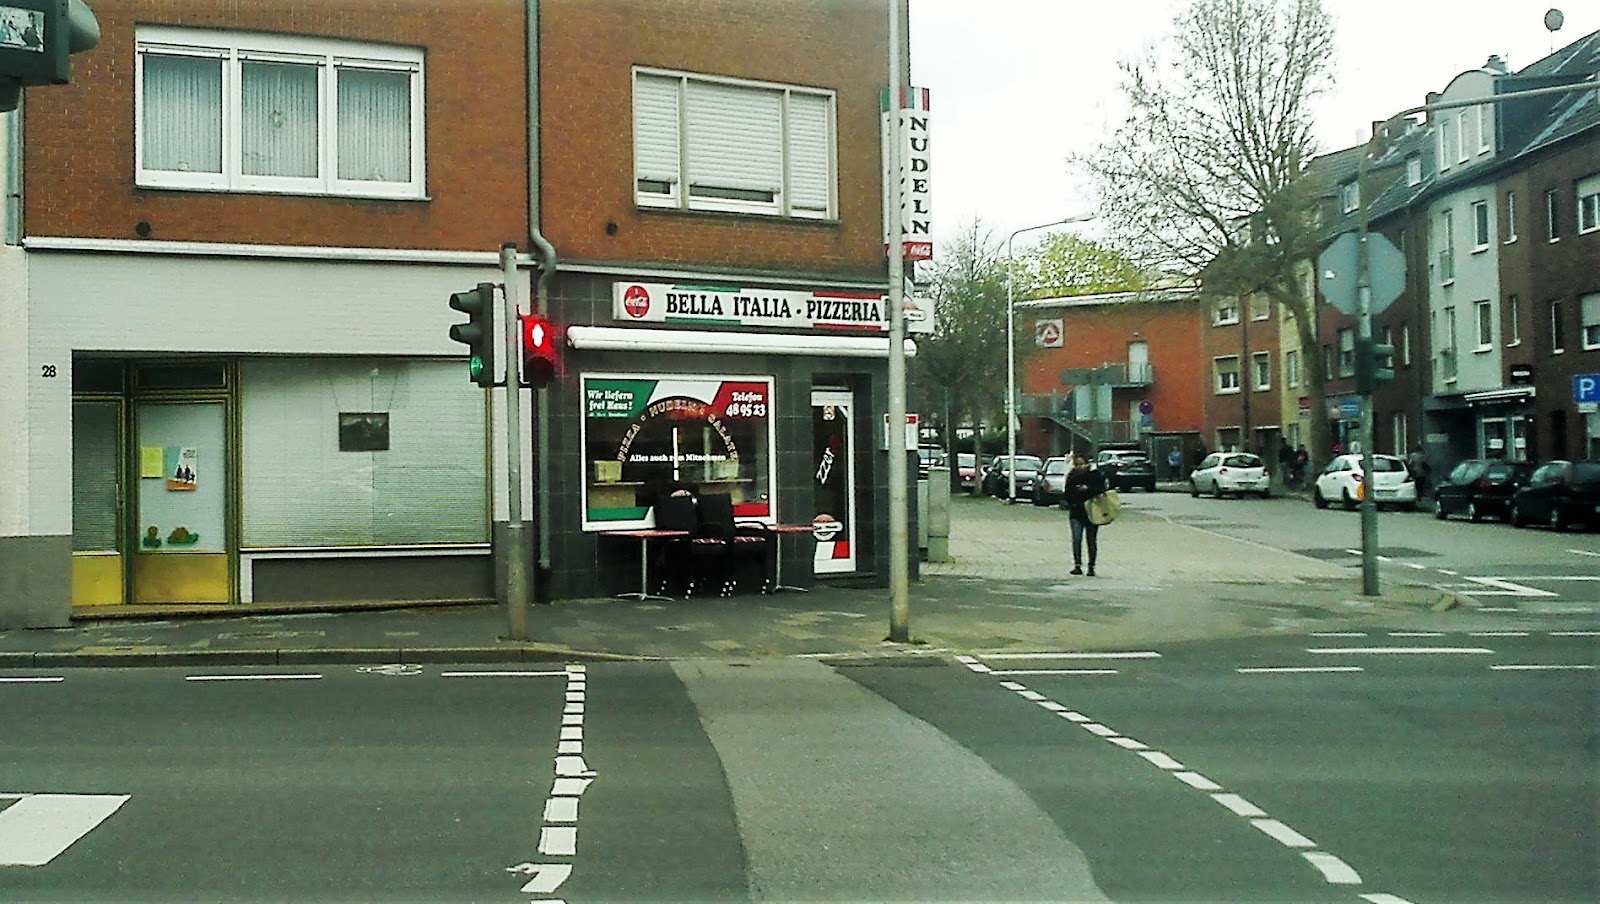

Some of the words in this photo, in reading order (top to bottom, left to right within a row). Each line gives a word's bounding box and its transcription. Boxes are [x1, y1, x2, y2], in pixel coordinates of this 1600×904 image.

[910, 117, 930, 234] NUDELN
[666, 294, 724, 315] BELLA
[733, 296, 791, 318] ITALIA
[806, 300, 880, 321] PIZZERIA
[42, 365, 56, 378] 28
[587, 390, 603, 399] Wir
[604, 390, 633, 401] liefern
[1580, 378, 1595, 400] P
[731, 391, 763, 403] Telefon
[589, 400, 605, 411] frei
[726, 403, 739, 417] 48
[629, 454, 649, 462] Alles
[649, 454, 668, 462] auch
